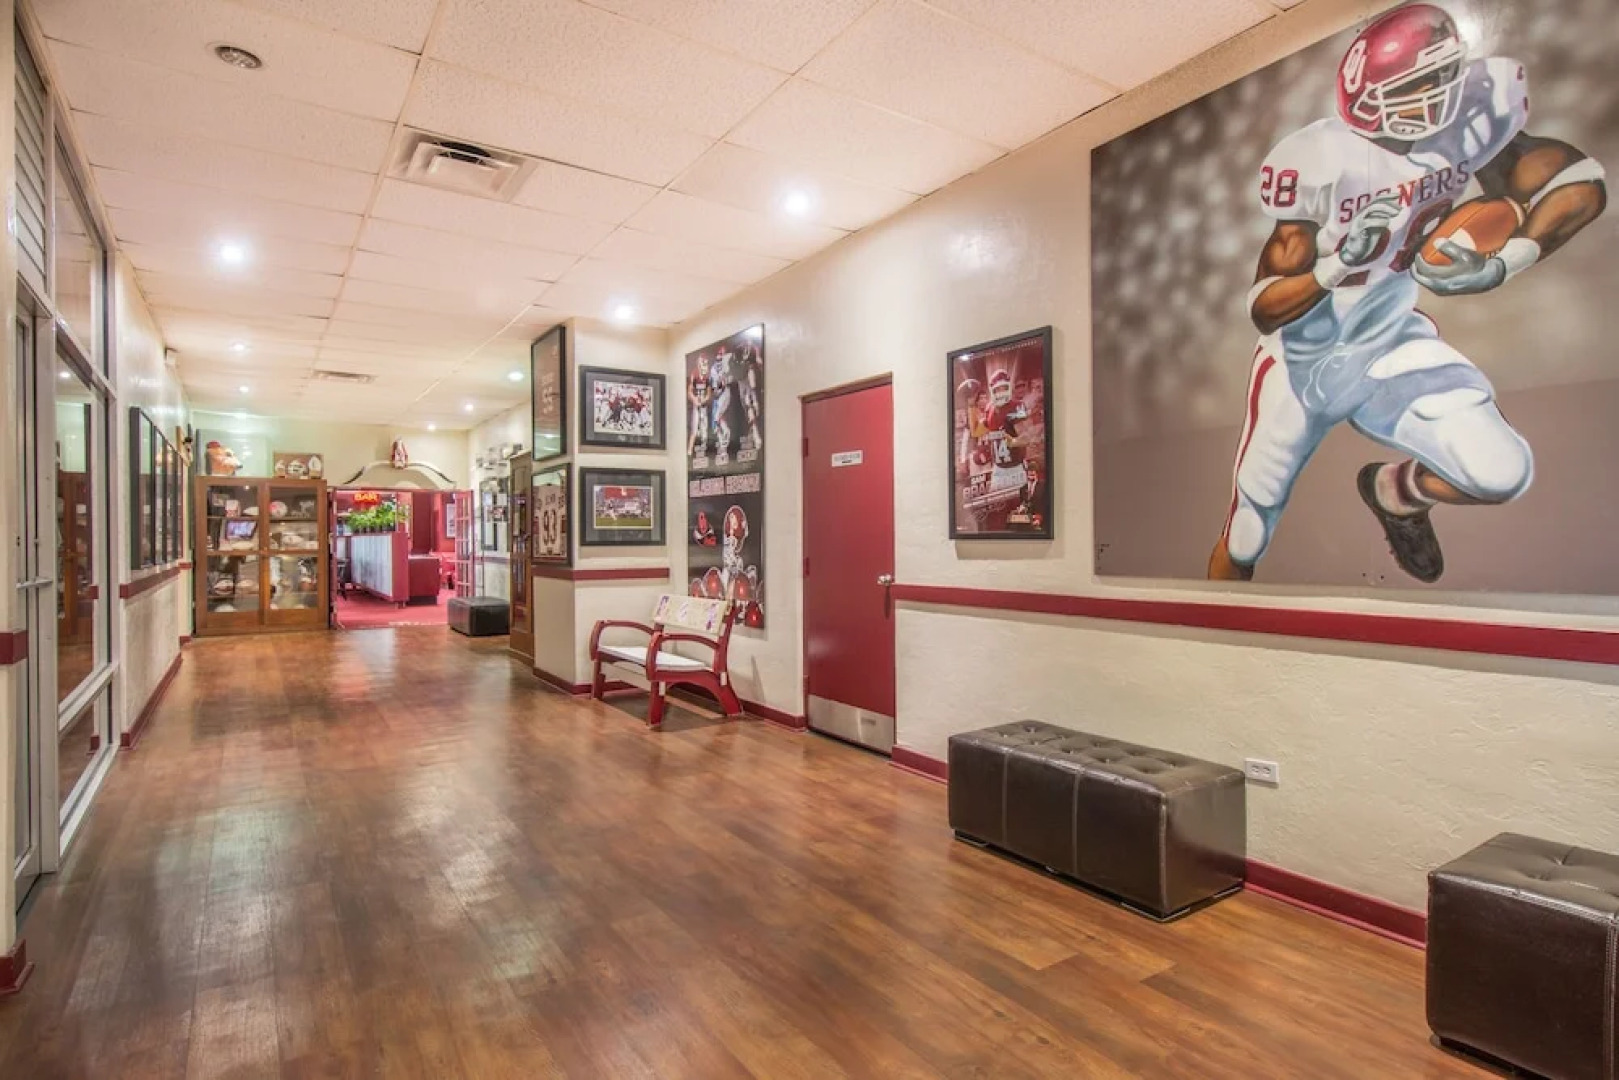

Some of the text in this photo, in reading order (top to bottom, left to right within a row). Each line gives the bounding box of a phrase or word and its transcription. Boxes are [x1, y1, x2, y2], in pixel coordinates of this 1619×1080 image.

[1260, 166, 1300, 208] 28
[1339, 160, 1470, 223] SONERS
[993, 438, 1012, 463] 14
[354, 492, 380, 503] BAR
[543, 509, 558, 547] 93
